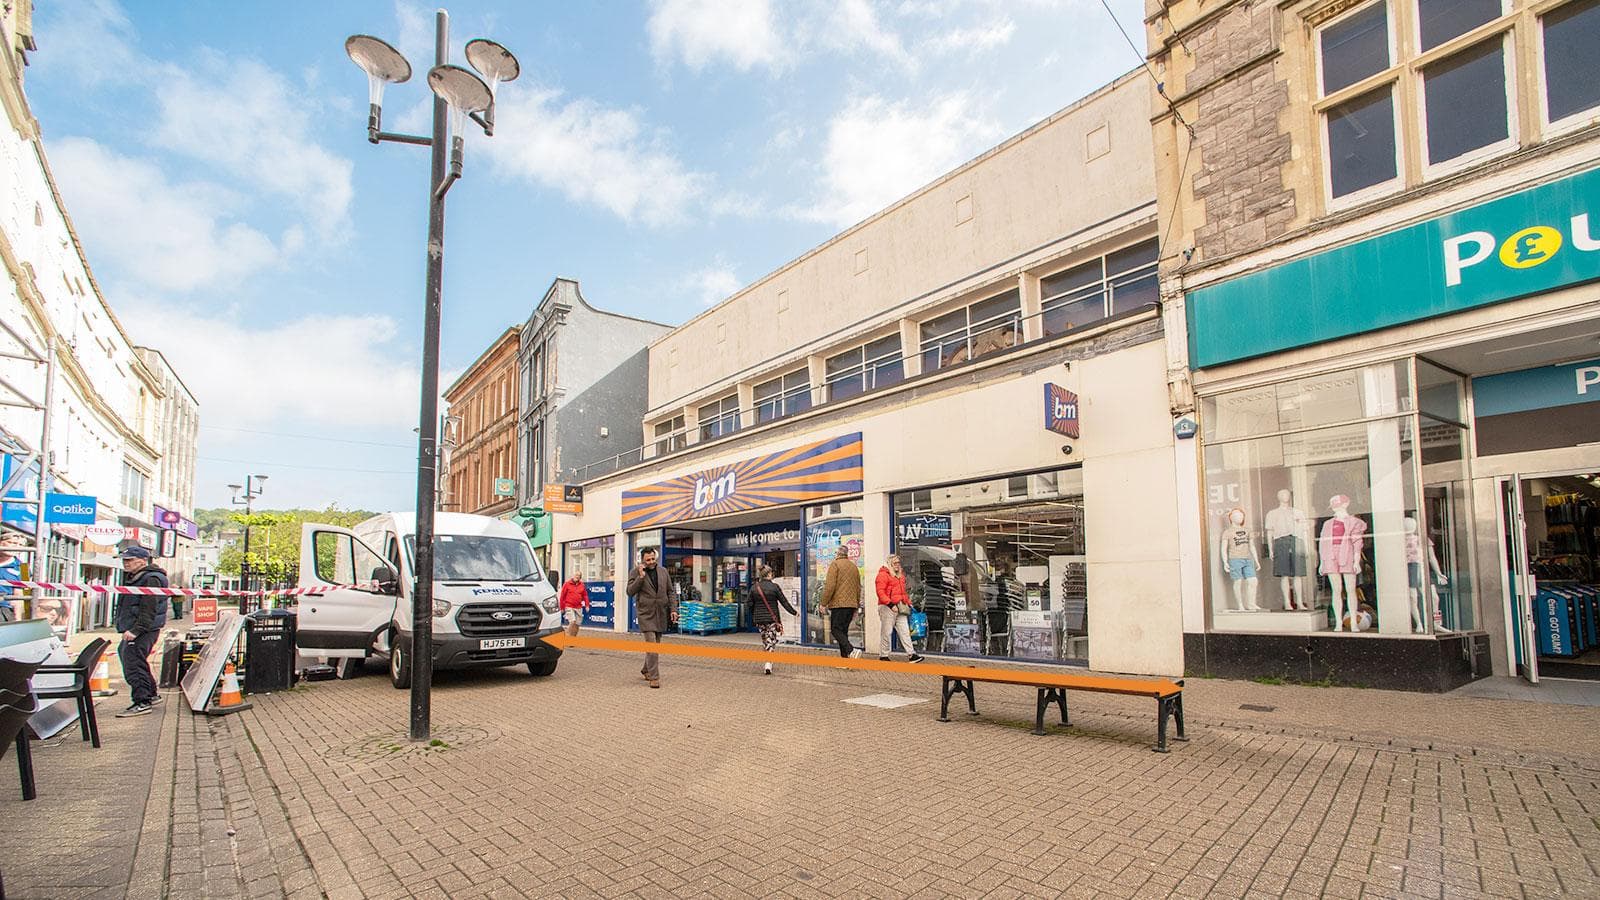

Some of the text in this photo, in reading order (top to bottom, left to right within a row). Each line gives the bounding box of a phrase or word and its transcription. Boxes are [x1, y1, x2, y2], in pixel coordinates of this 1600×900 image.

[53, 503, 94, 514] optika
[735, 530, 780, 545] Welcome
[783, 528, 795, 541] to
[1549, 617, 1559, 633] GOT
[483, 639, 521, 648] HJ75 FPL
[1551, 633, 1562, 654] GUM?
